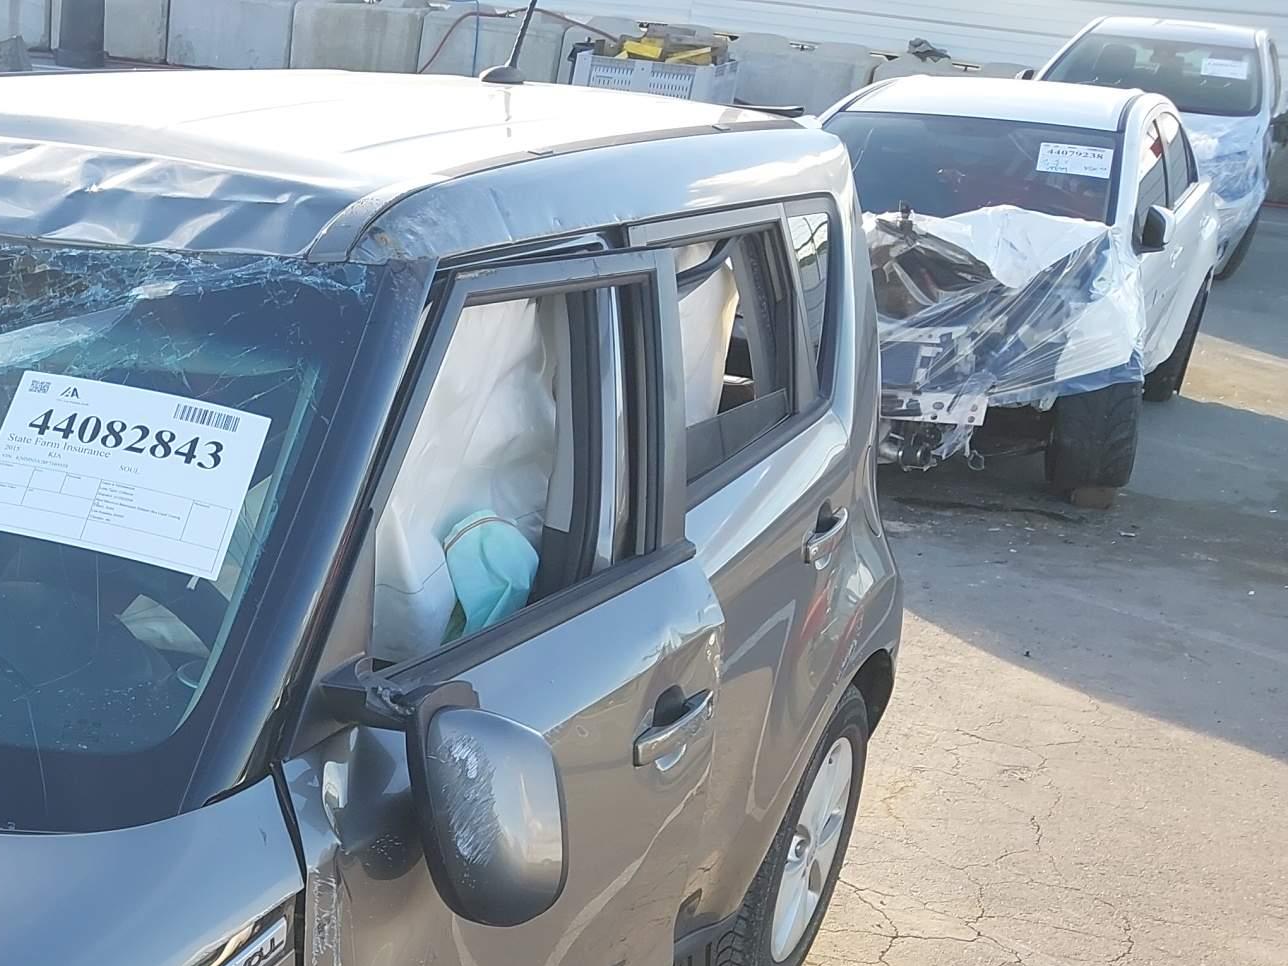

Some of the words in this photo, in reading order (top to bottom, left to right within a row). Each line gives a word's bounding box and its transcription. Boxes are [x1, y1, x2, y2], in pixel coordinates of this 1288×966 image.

[1047, 149, 1104, 160] 44079238
[7, 432, 33, 445] State
[34, 437, 60, 450] Farm
[63, 441, 112, 459] Insurance
[28, 408, 224, 469] 44082843
